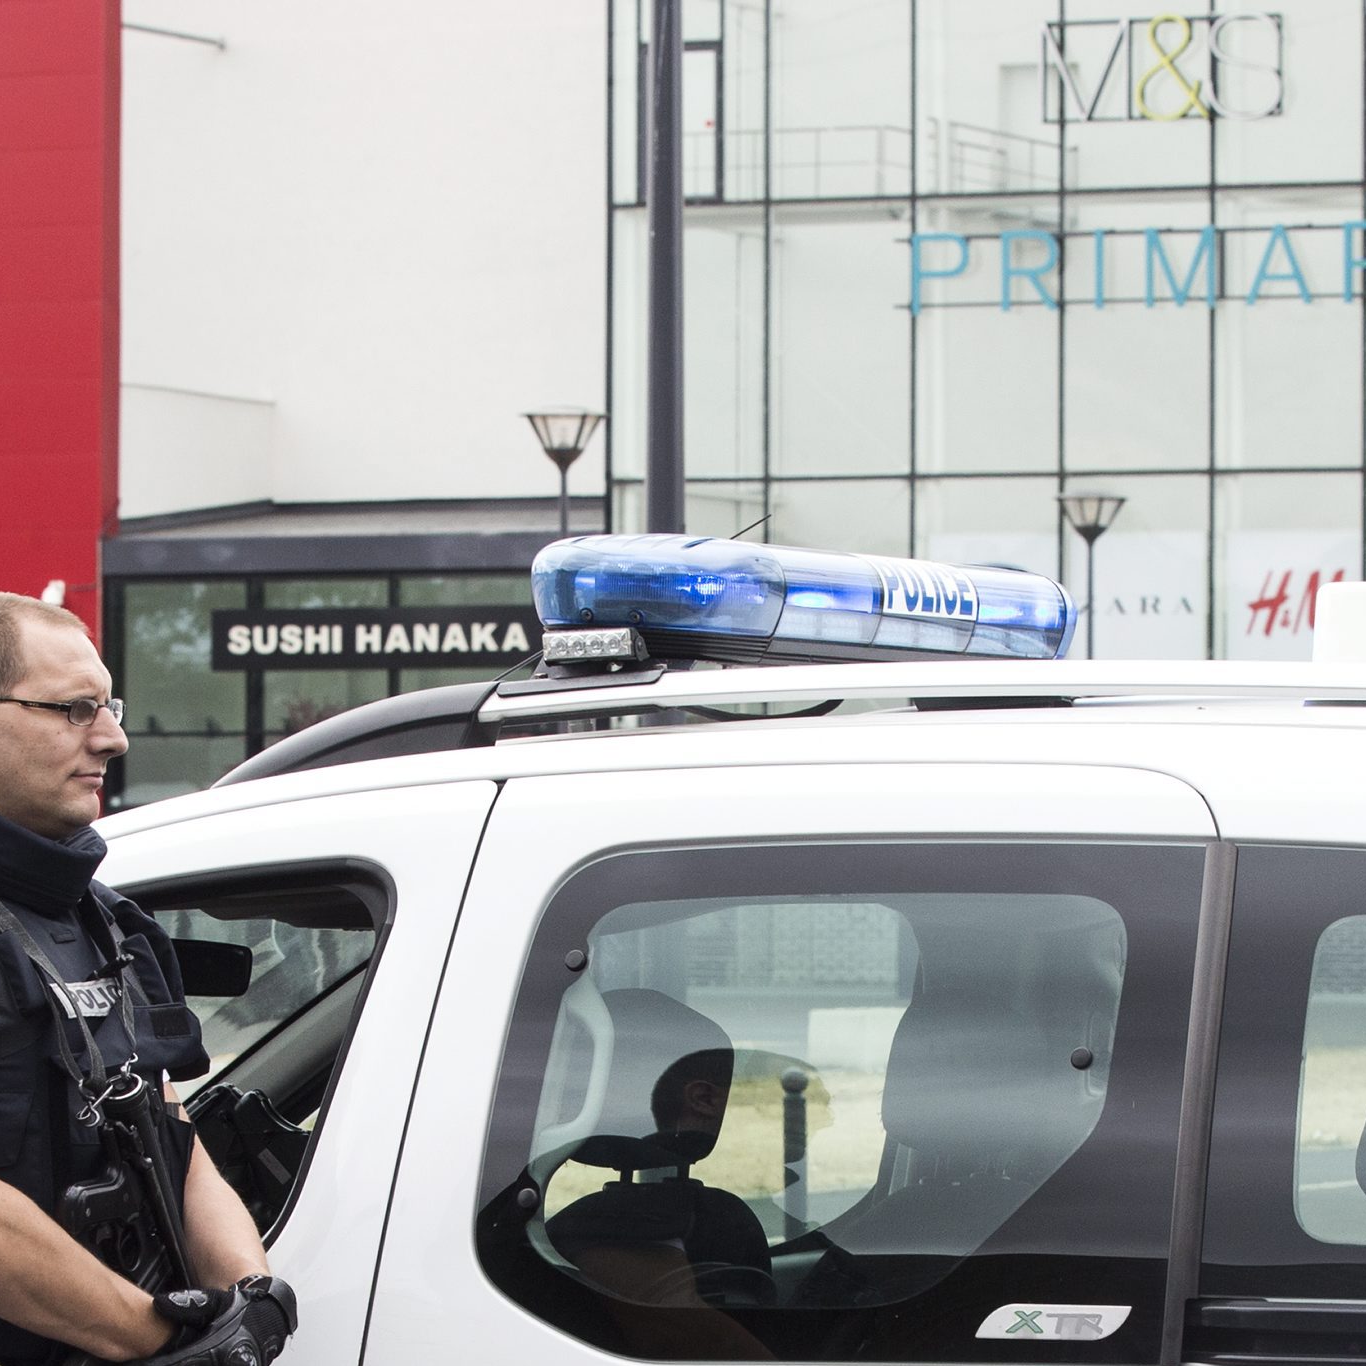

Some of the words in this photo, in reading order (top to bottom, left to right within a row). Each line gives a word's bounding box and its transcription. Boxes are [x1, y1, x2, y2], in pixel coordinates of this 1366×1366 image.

[1039, 13, 1283, 122] M&S
[882, 557, 974, 616] POLICE
[1245, 568, 1345, 637] H&M
[227, 624, 343, 655] SUSHI
[354, 622, 530, 654] HANAKA
[68, 984, 123, 1010] POLIC
[1005, 1310, 1103, 1335] XTR
